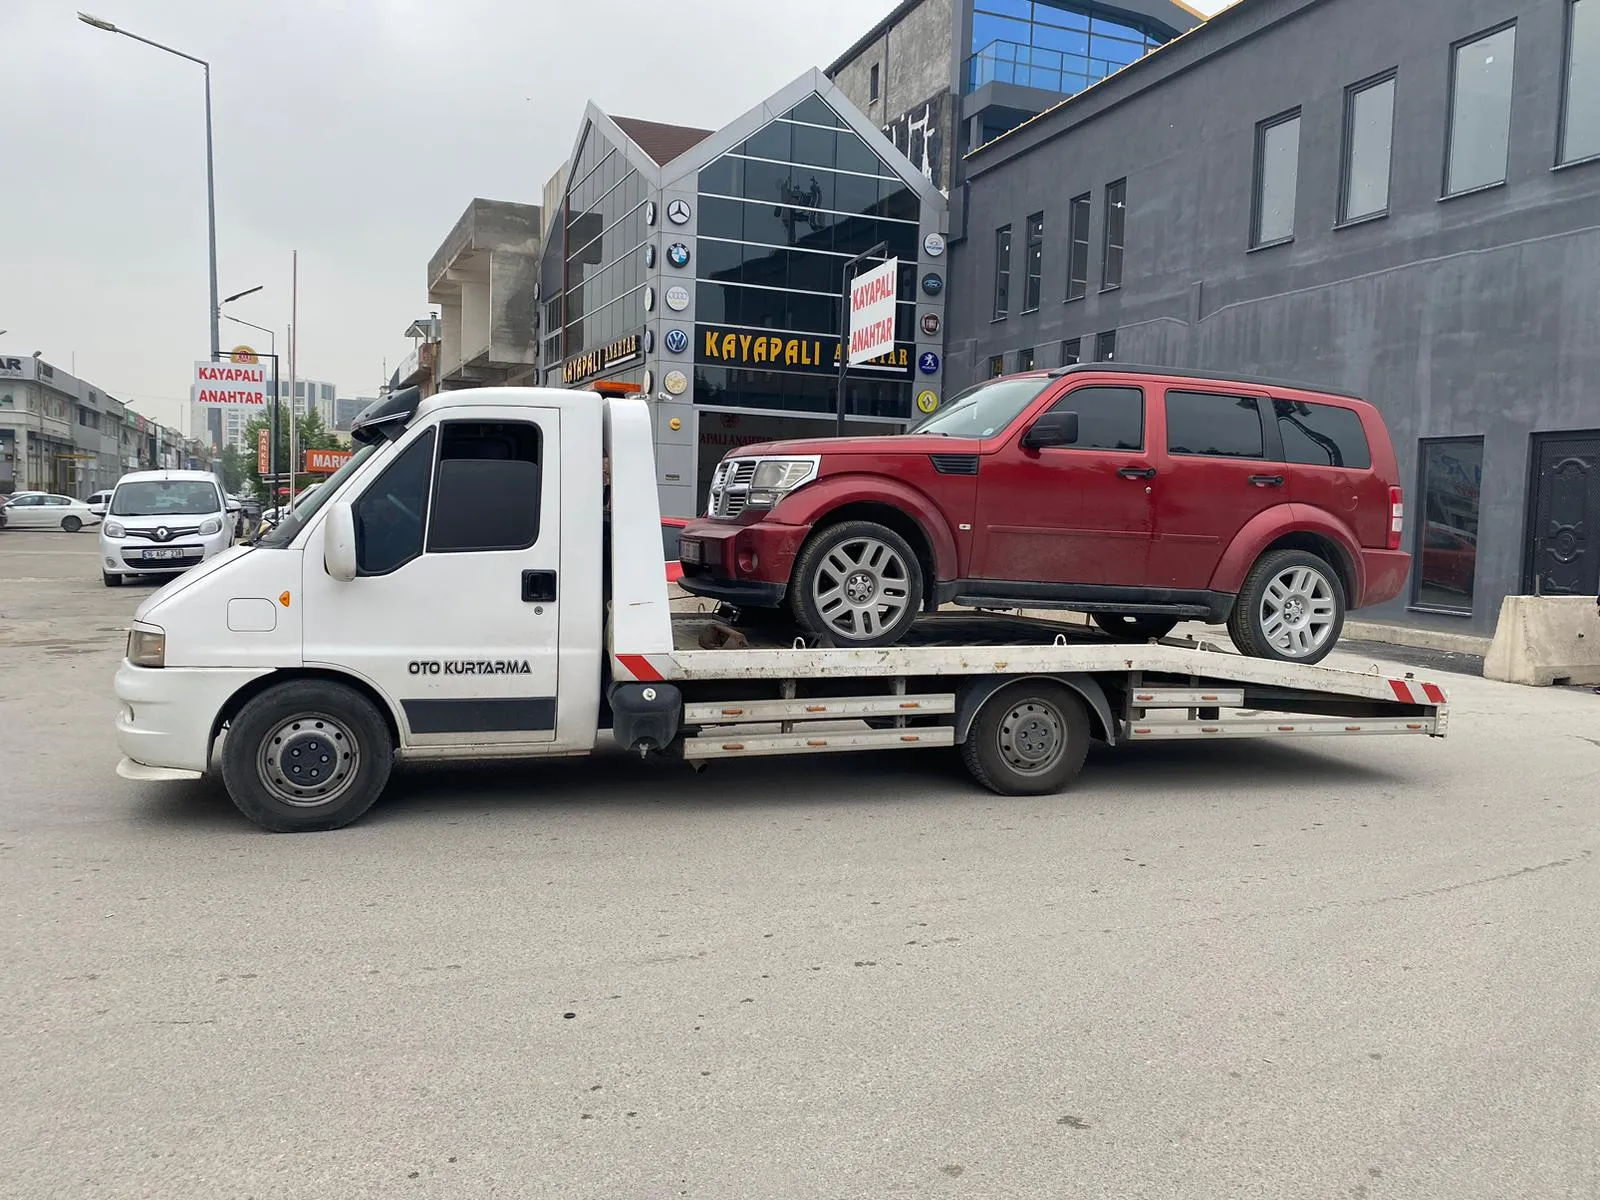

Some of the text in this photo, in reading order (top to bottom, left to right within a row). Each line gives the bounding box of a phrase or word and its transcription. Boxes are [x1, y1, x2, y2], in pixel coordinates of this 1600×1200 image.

[853, 270, 895, 312] KAYAPALI
[705, 331, 820, 366] KAYAPALI
[851, 317, 893, 354] ANAHTAR
[198, 367, 263, 383] KAYAPALI
[563, 334, 636, 384] KAYAPALI ANAHTAR
[199, 389, 264, 405] ANAHTAR
[259, 430, 269, 473] MARKET
[312, 454, 353, 468] MARK
[408, 660, 531, 675] OTO KURTARMA
